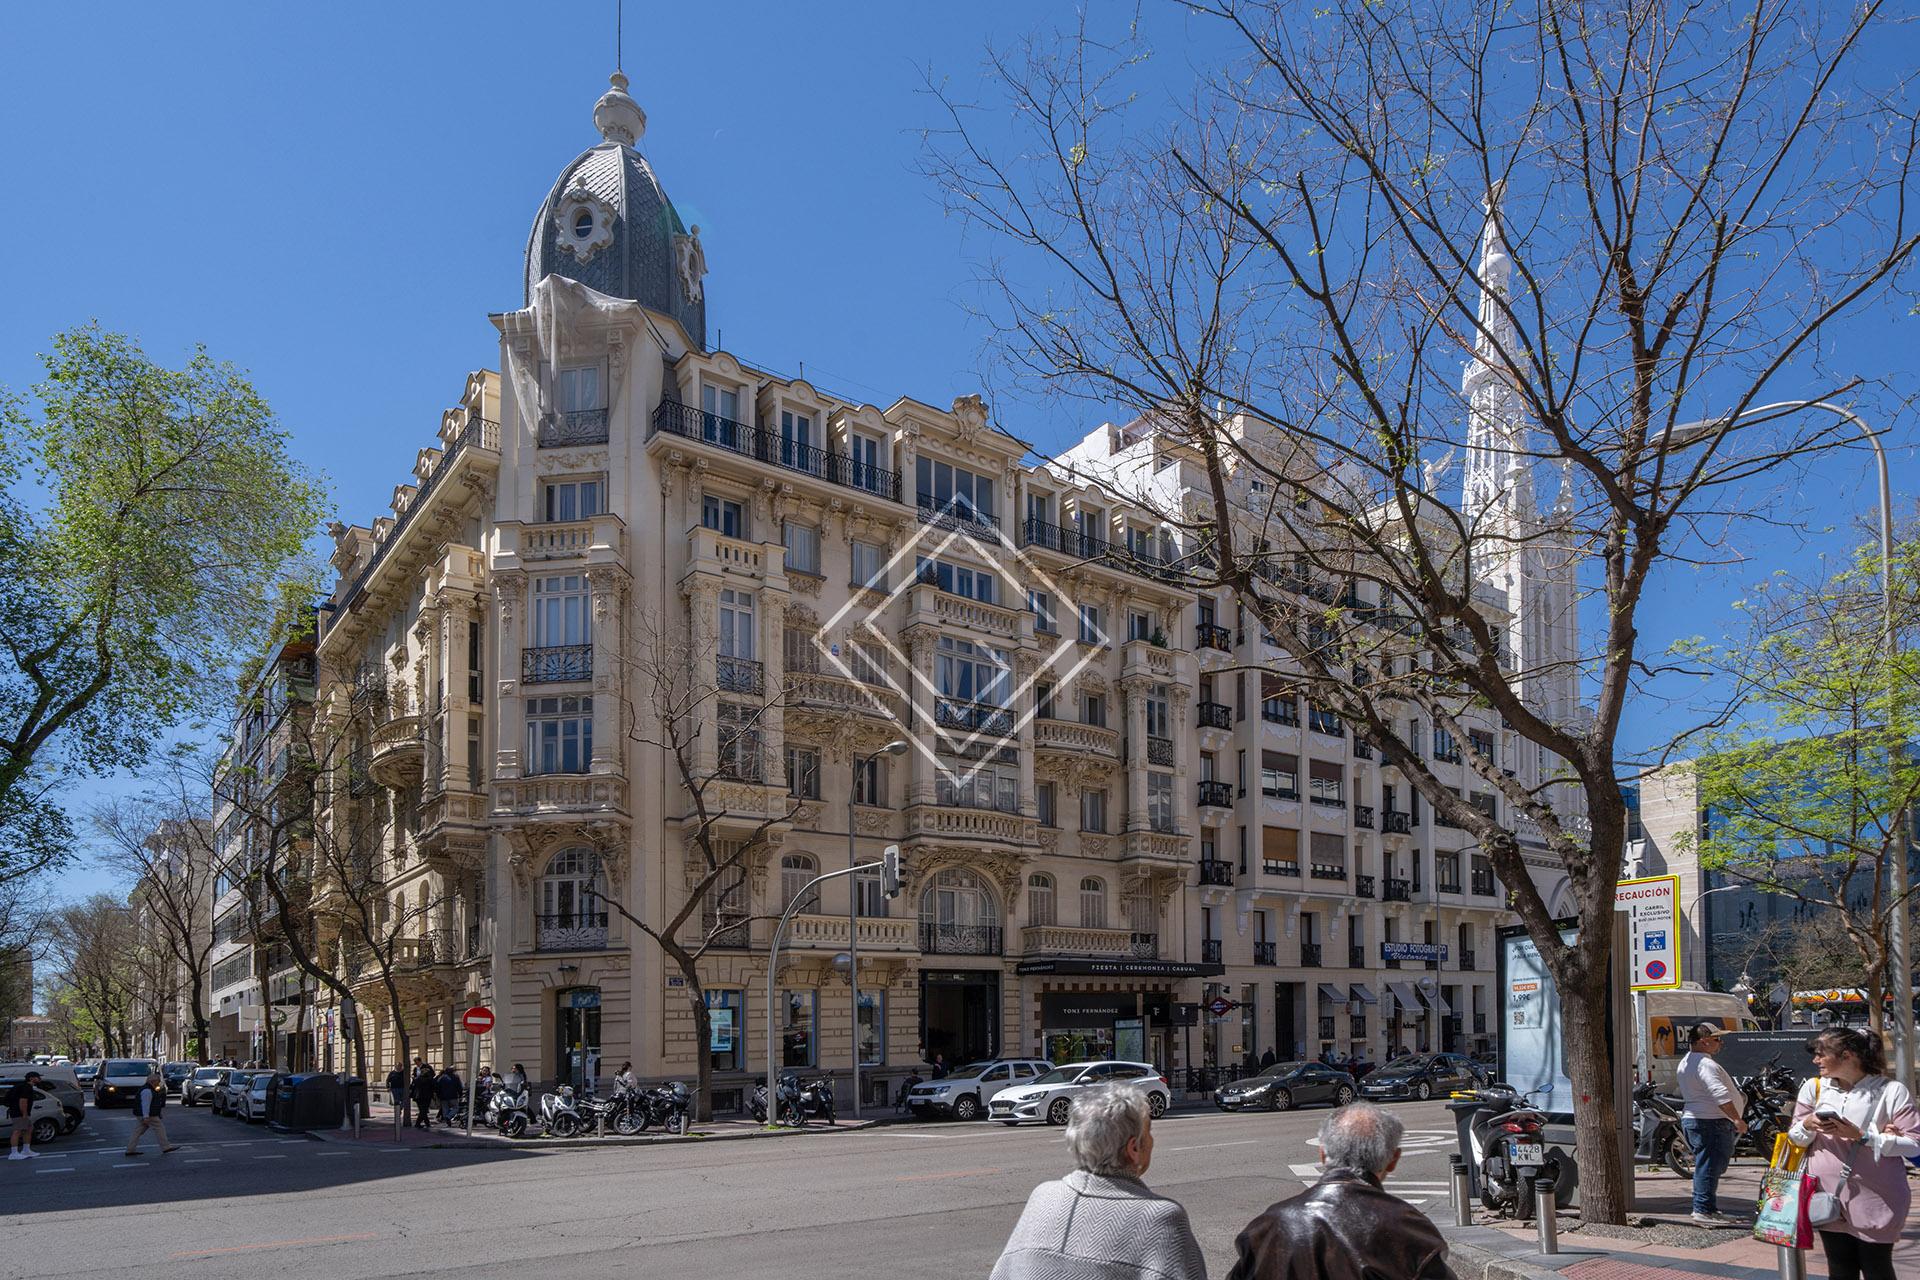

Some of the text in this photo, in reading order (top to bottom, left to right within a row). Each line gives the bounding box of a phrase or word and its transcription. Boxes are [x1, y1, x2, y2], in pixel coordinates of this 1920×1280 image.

[1613, 886, 1670, 901] RECAUCIÓN
[1384, 943, 1447, 954] ESTUDIO FOTOGRAFCO
[1391, 952, 1428, 960] Victoria
